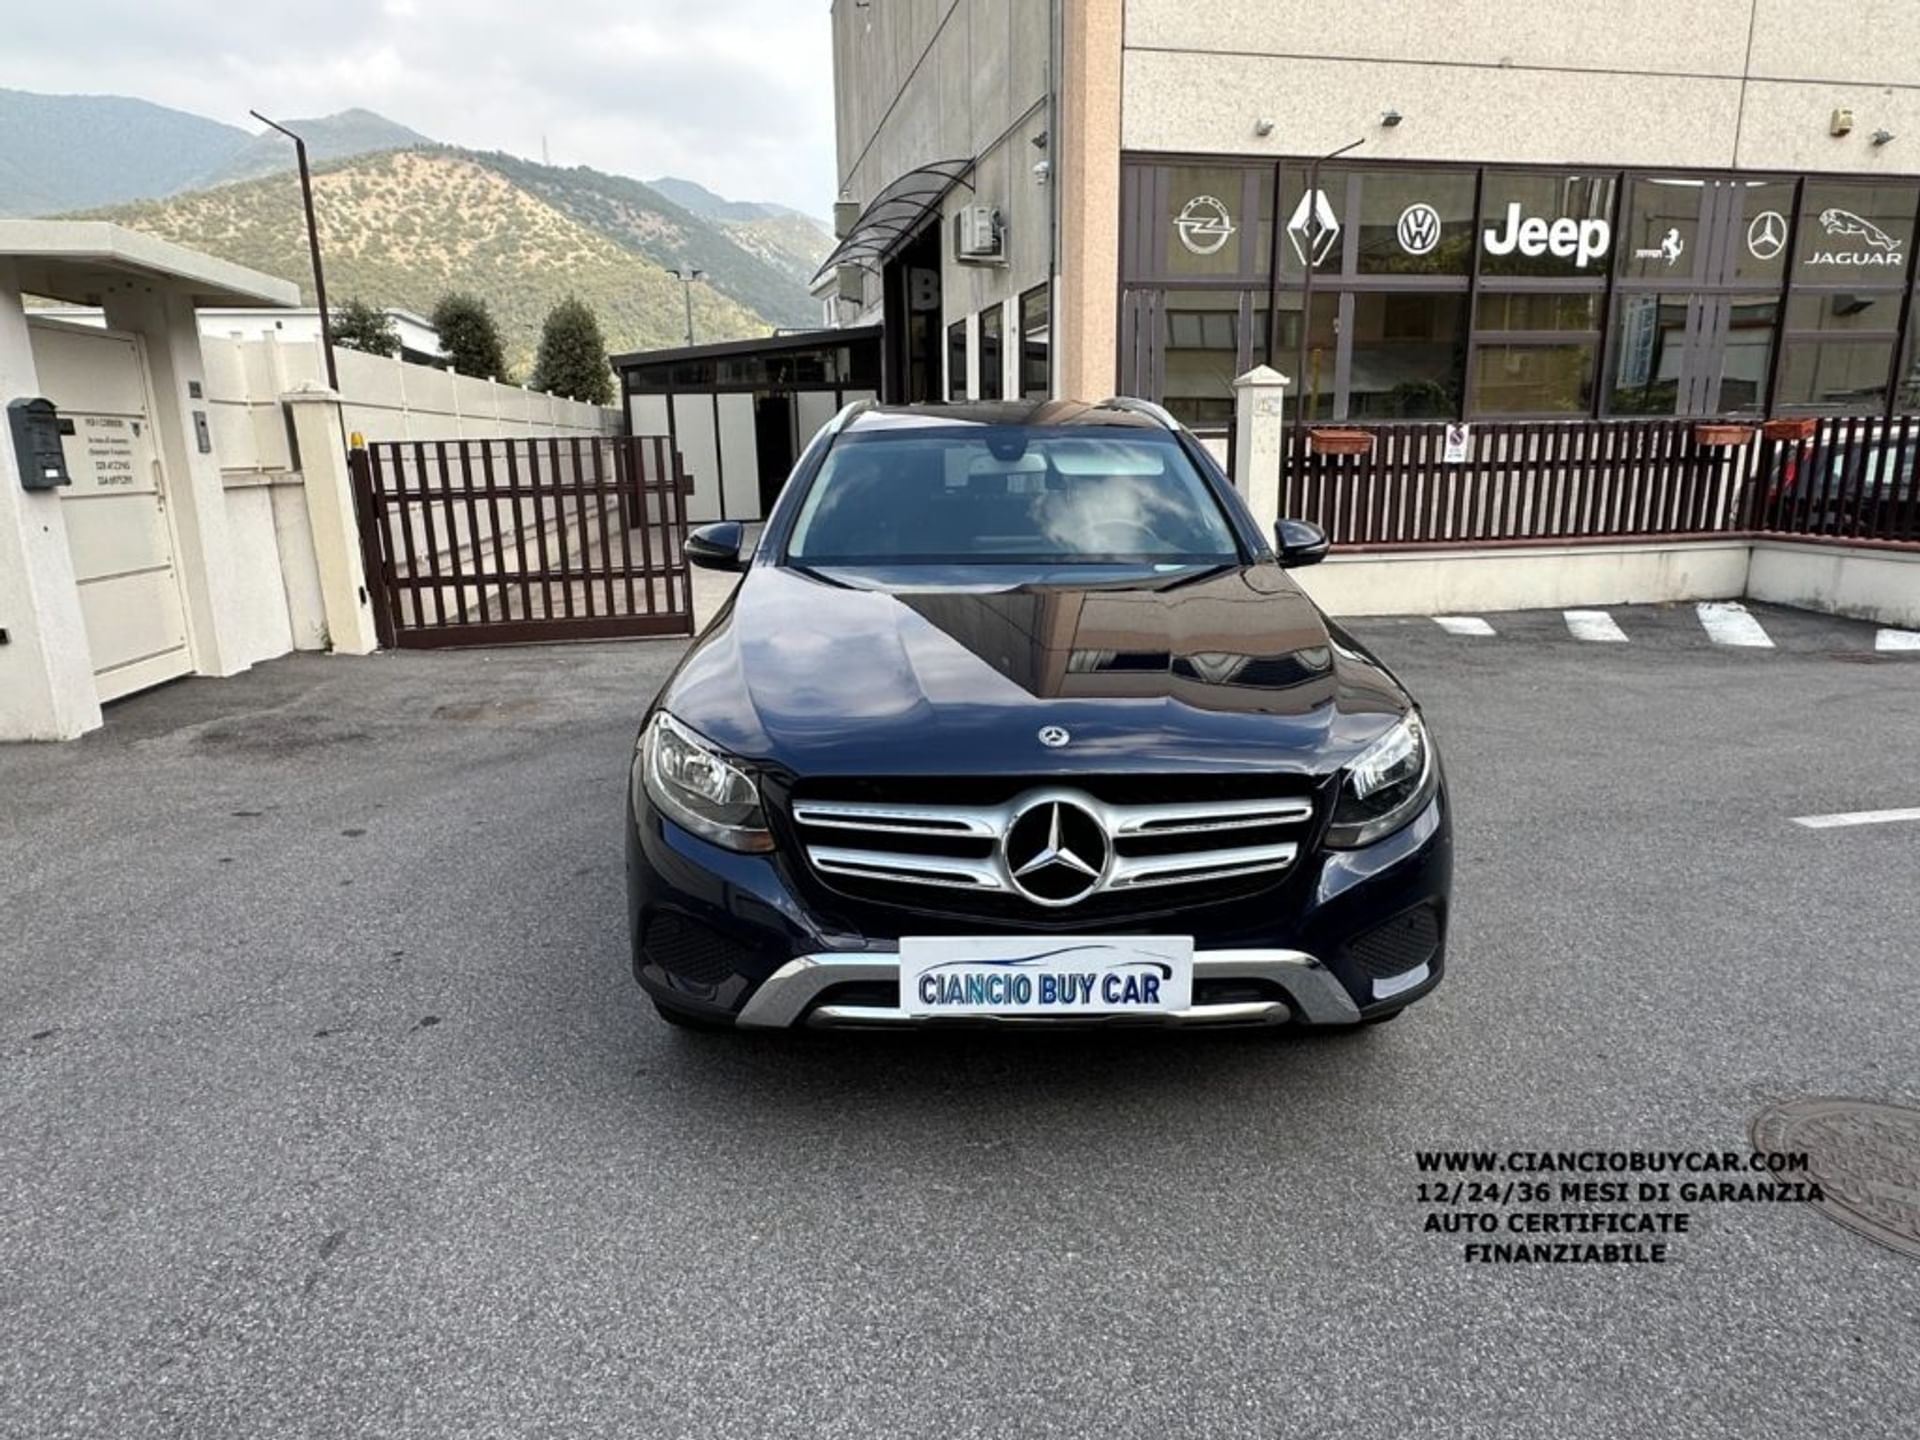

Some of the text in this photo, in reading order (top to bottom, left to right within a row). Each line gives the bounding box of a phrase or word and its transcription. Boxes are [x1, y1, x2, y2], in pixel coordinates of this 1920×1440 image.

[1484, 203, 1610, 267] Jeep
[1804, 252, 1902, 266] JAGUAR
[918, 973, 1162, 1006] CIANCIO BUY CAR
